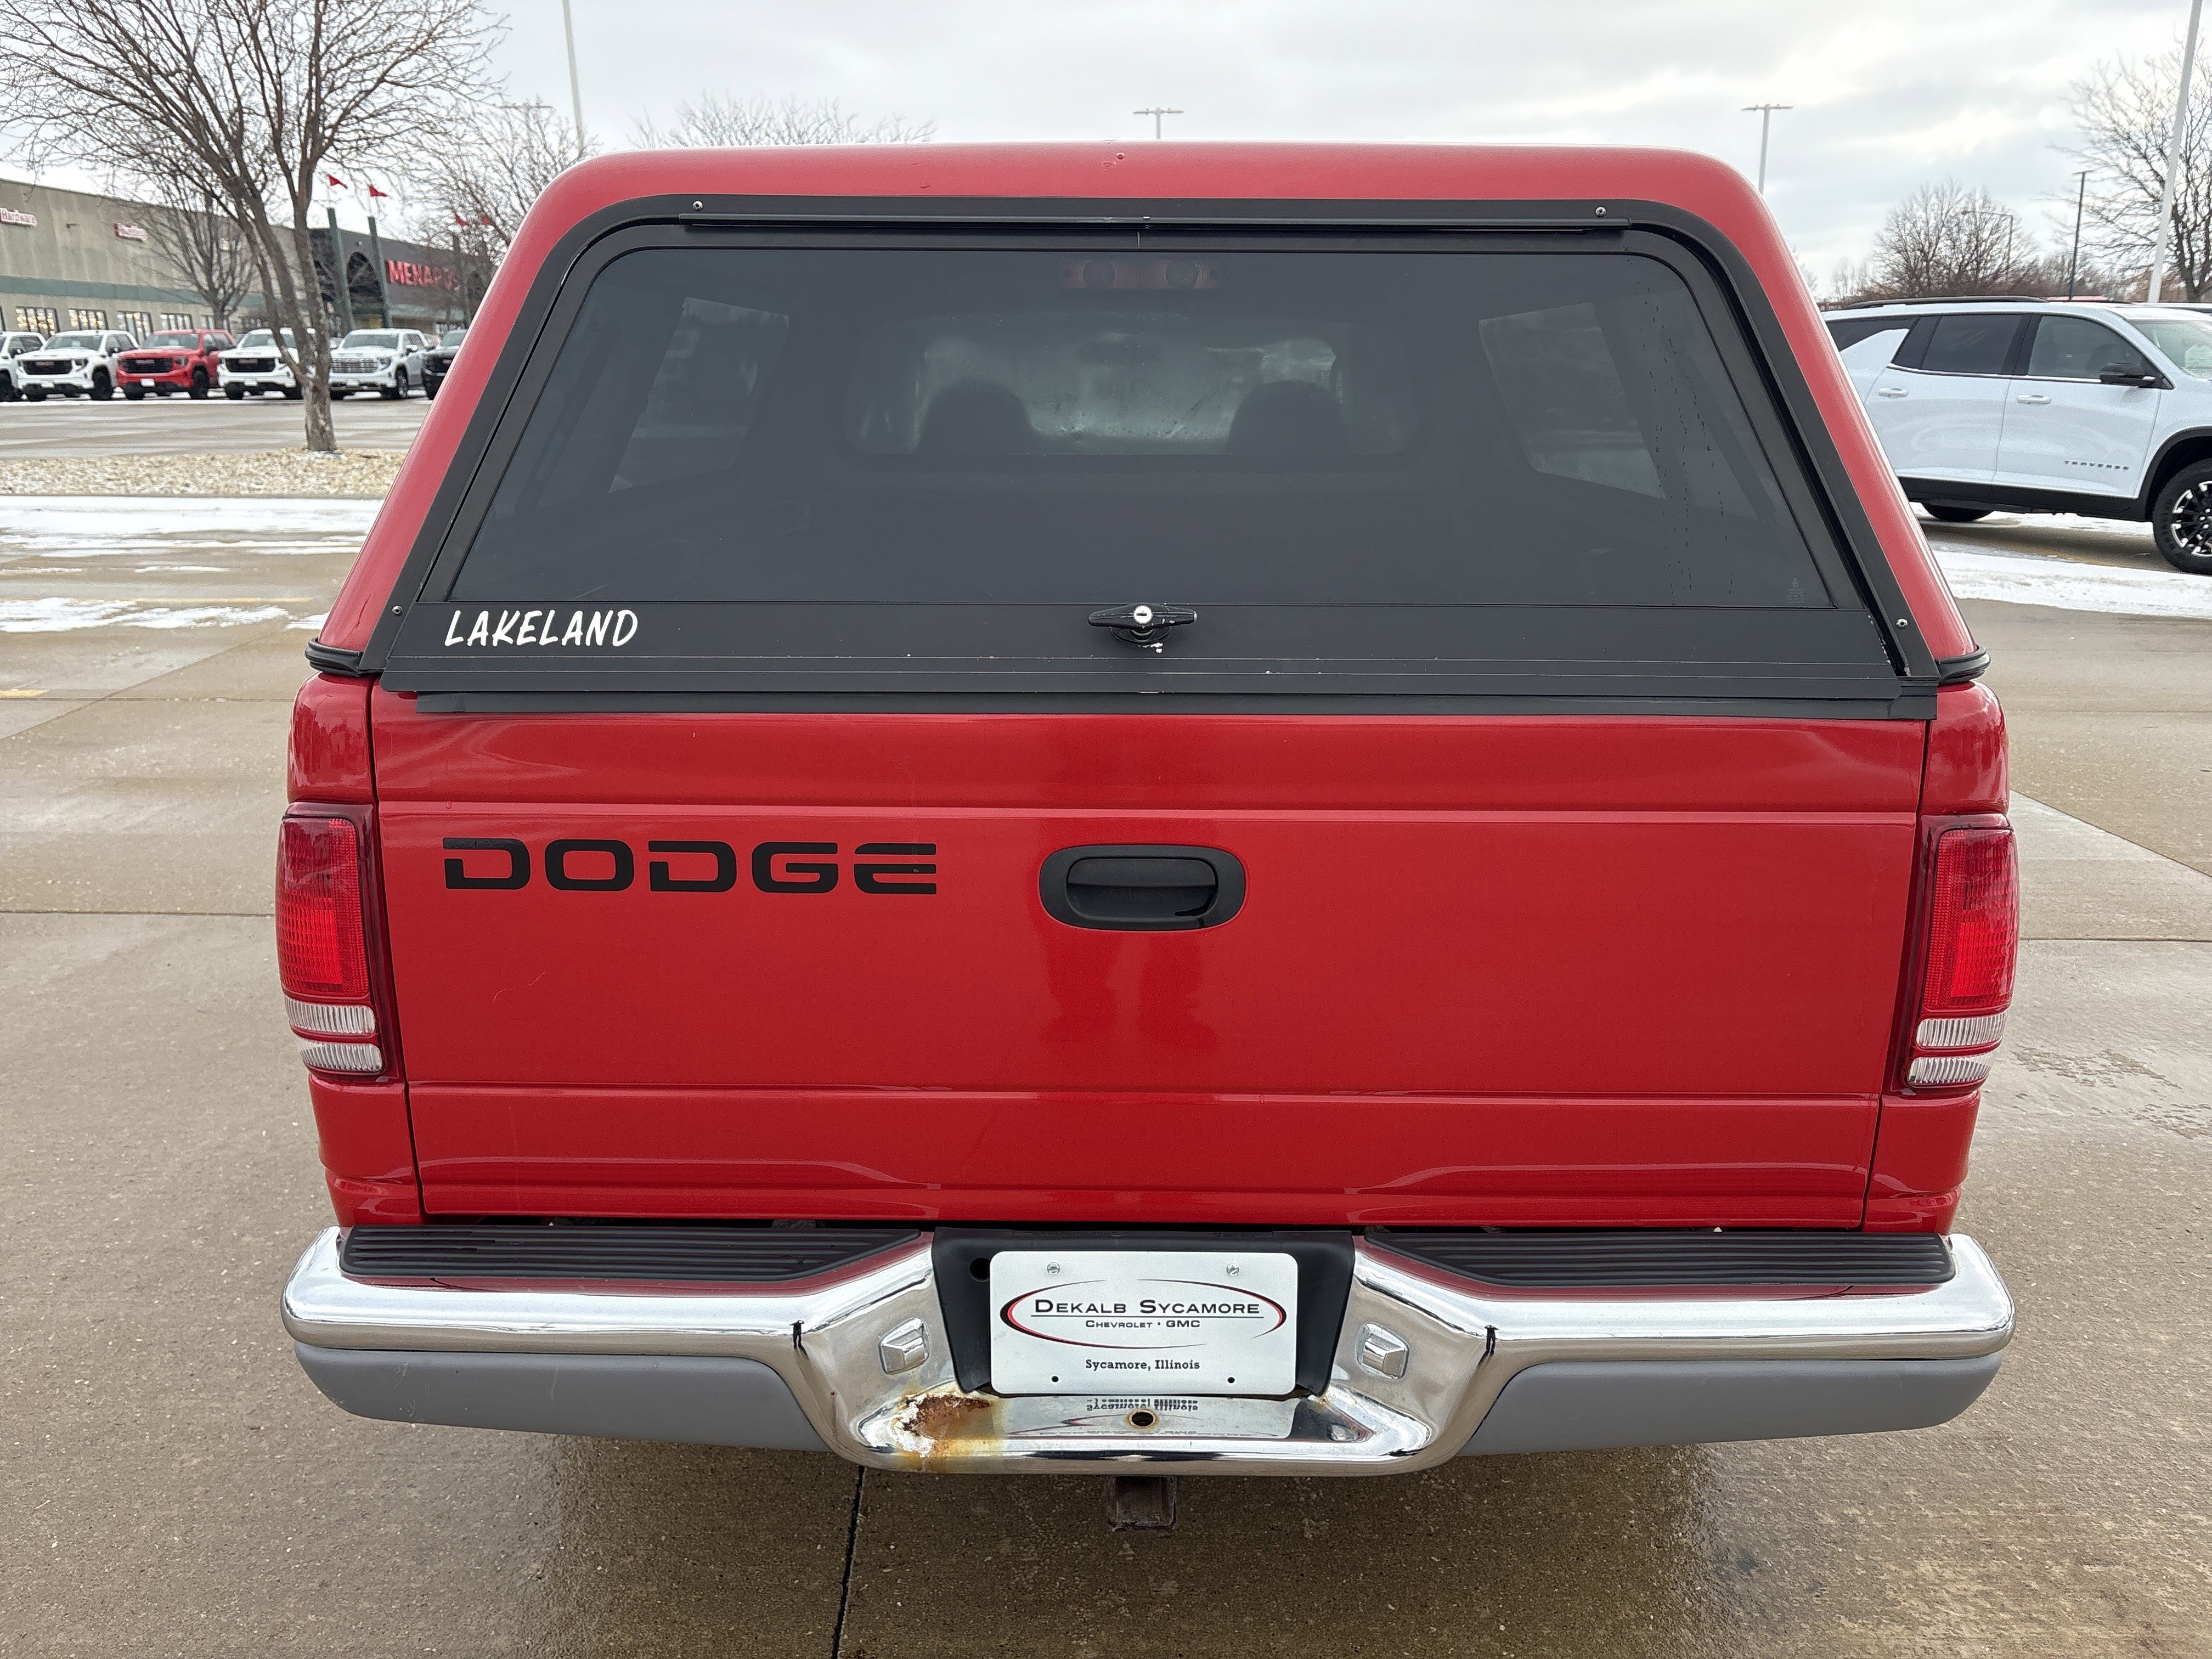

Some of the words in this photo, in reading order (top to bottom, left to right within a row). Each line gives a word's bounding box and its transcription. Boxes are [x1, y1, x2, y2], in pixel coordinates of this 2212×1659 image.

[2064, 460, 2129, 470] TRAVERSE
[444, 610, 638, 647] LAKELAND
[442, 837, 937, 895] DODGE
[1085, 1359, 1151, 1371] Sycamore,
[1154, 1359, 1200, 1370] Illinois
